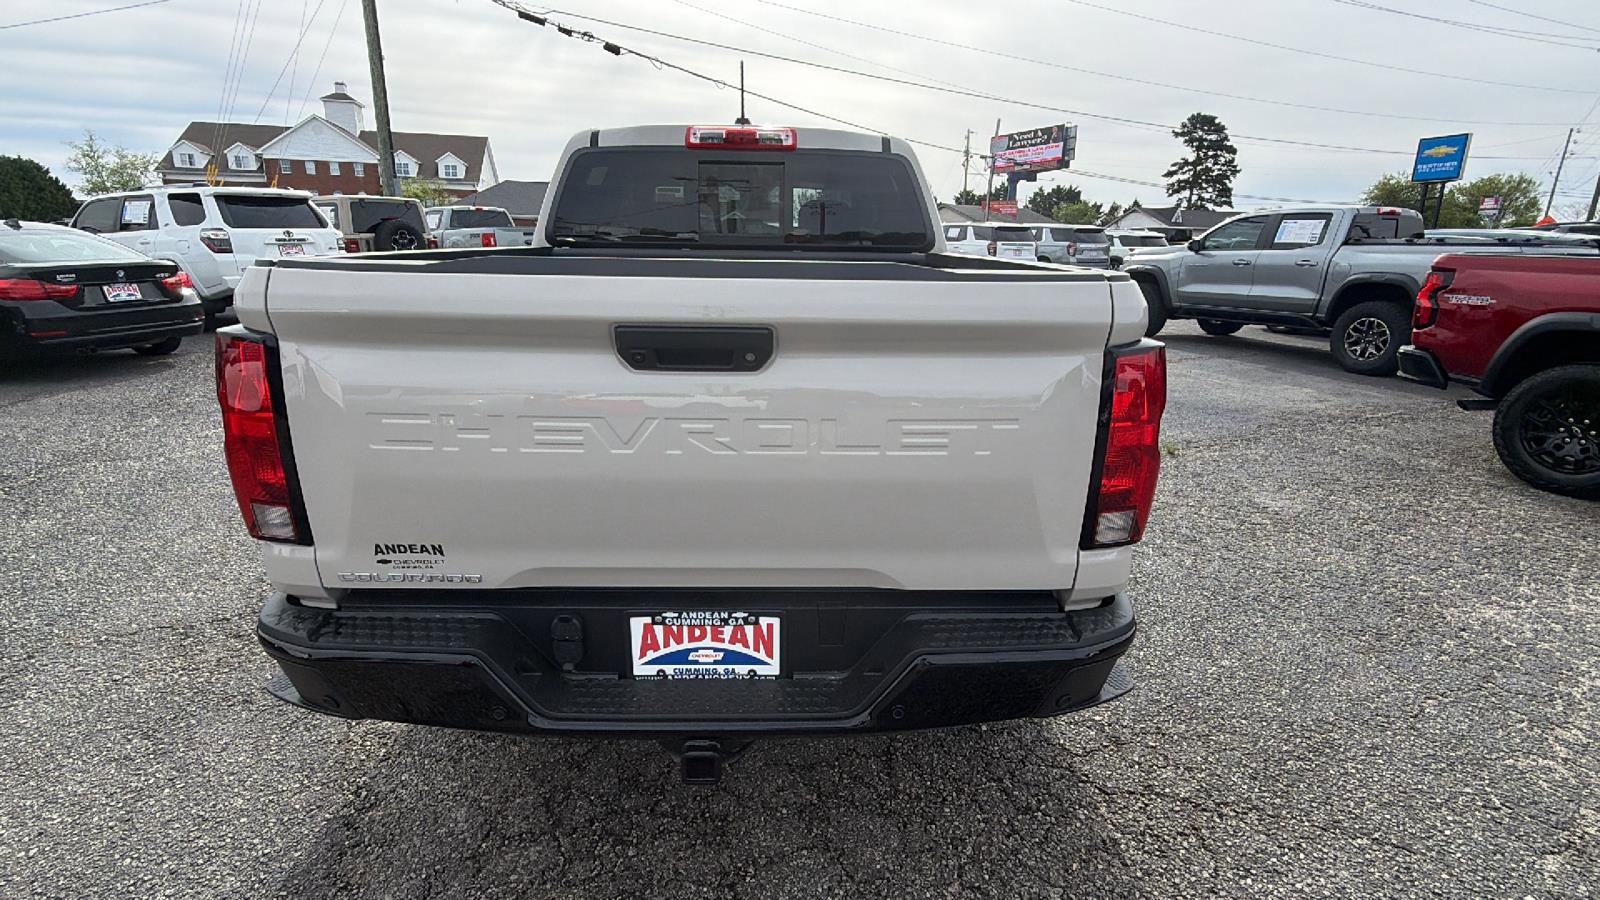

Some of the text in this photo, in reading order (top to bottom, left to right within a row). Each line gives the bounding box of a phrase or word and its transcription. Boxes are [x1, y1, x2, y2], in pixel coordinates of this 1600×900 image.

[1009, 135, 1048, 147] Lawyer?
[1013, 132, 1034, 141] Need
[106, 283, 139, 297] ANDEAN
[366, 411, 1020, 456] CHEVROLET
[374, 543, 445, 557] ANDEAN
[337, 572, 483, 584] COLORADO
[681, 611, 729, 619] ANDEAN
[665, 618, 745, 626] CUMMING, GA
[638, 622, 774, 661] ANDEAN
[673, 667, 721, 676] CUMMING,
